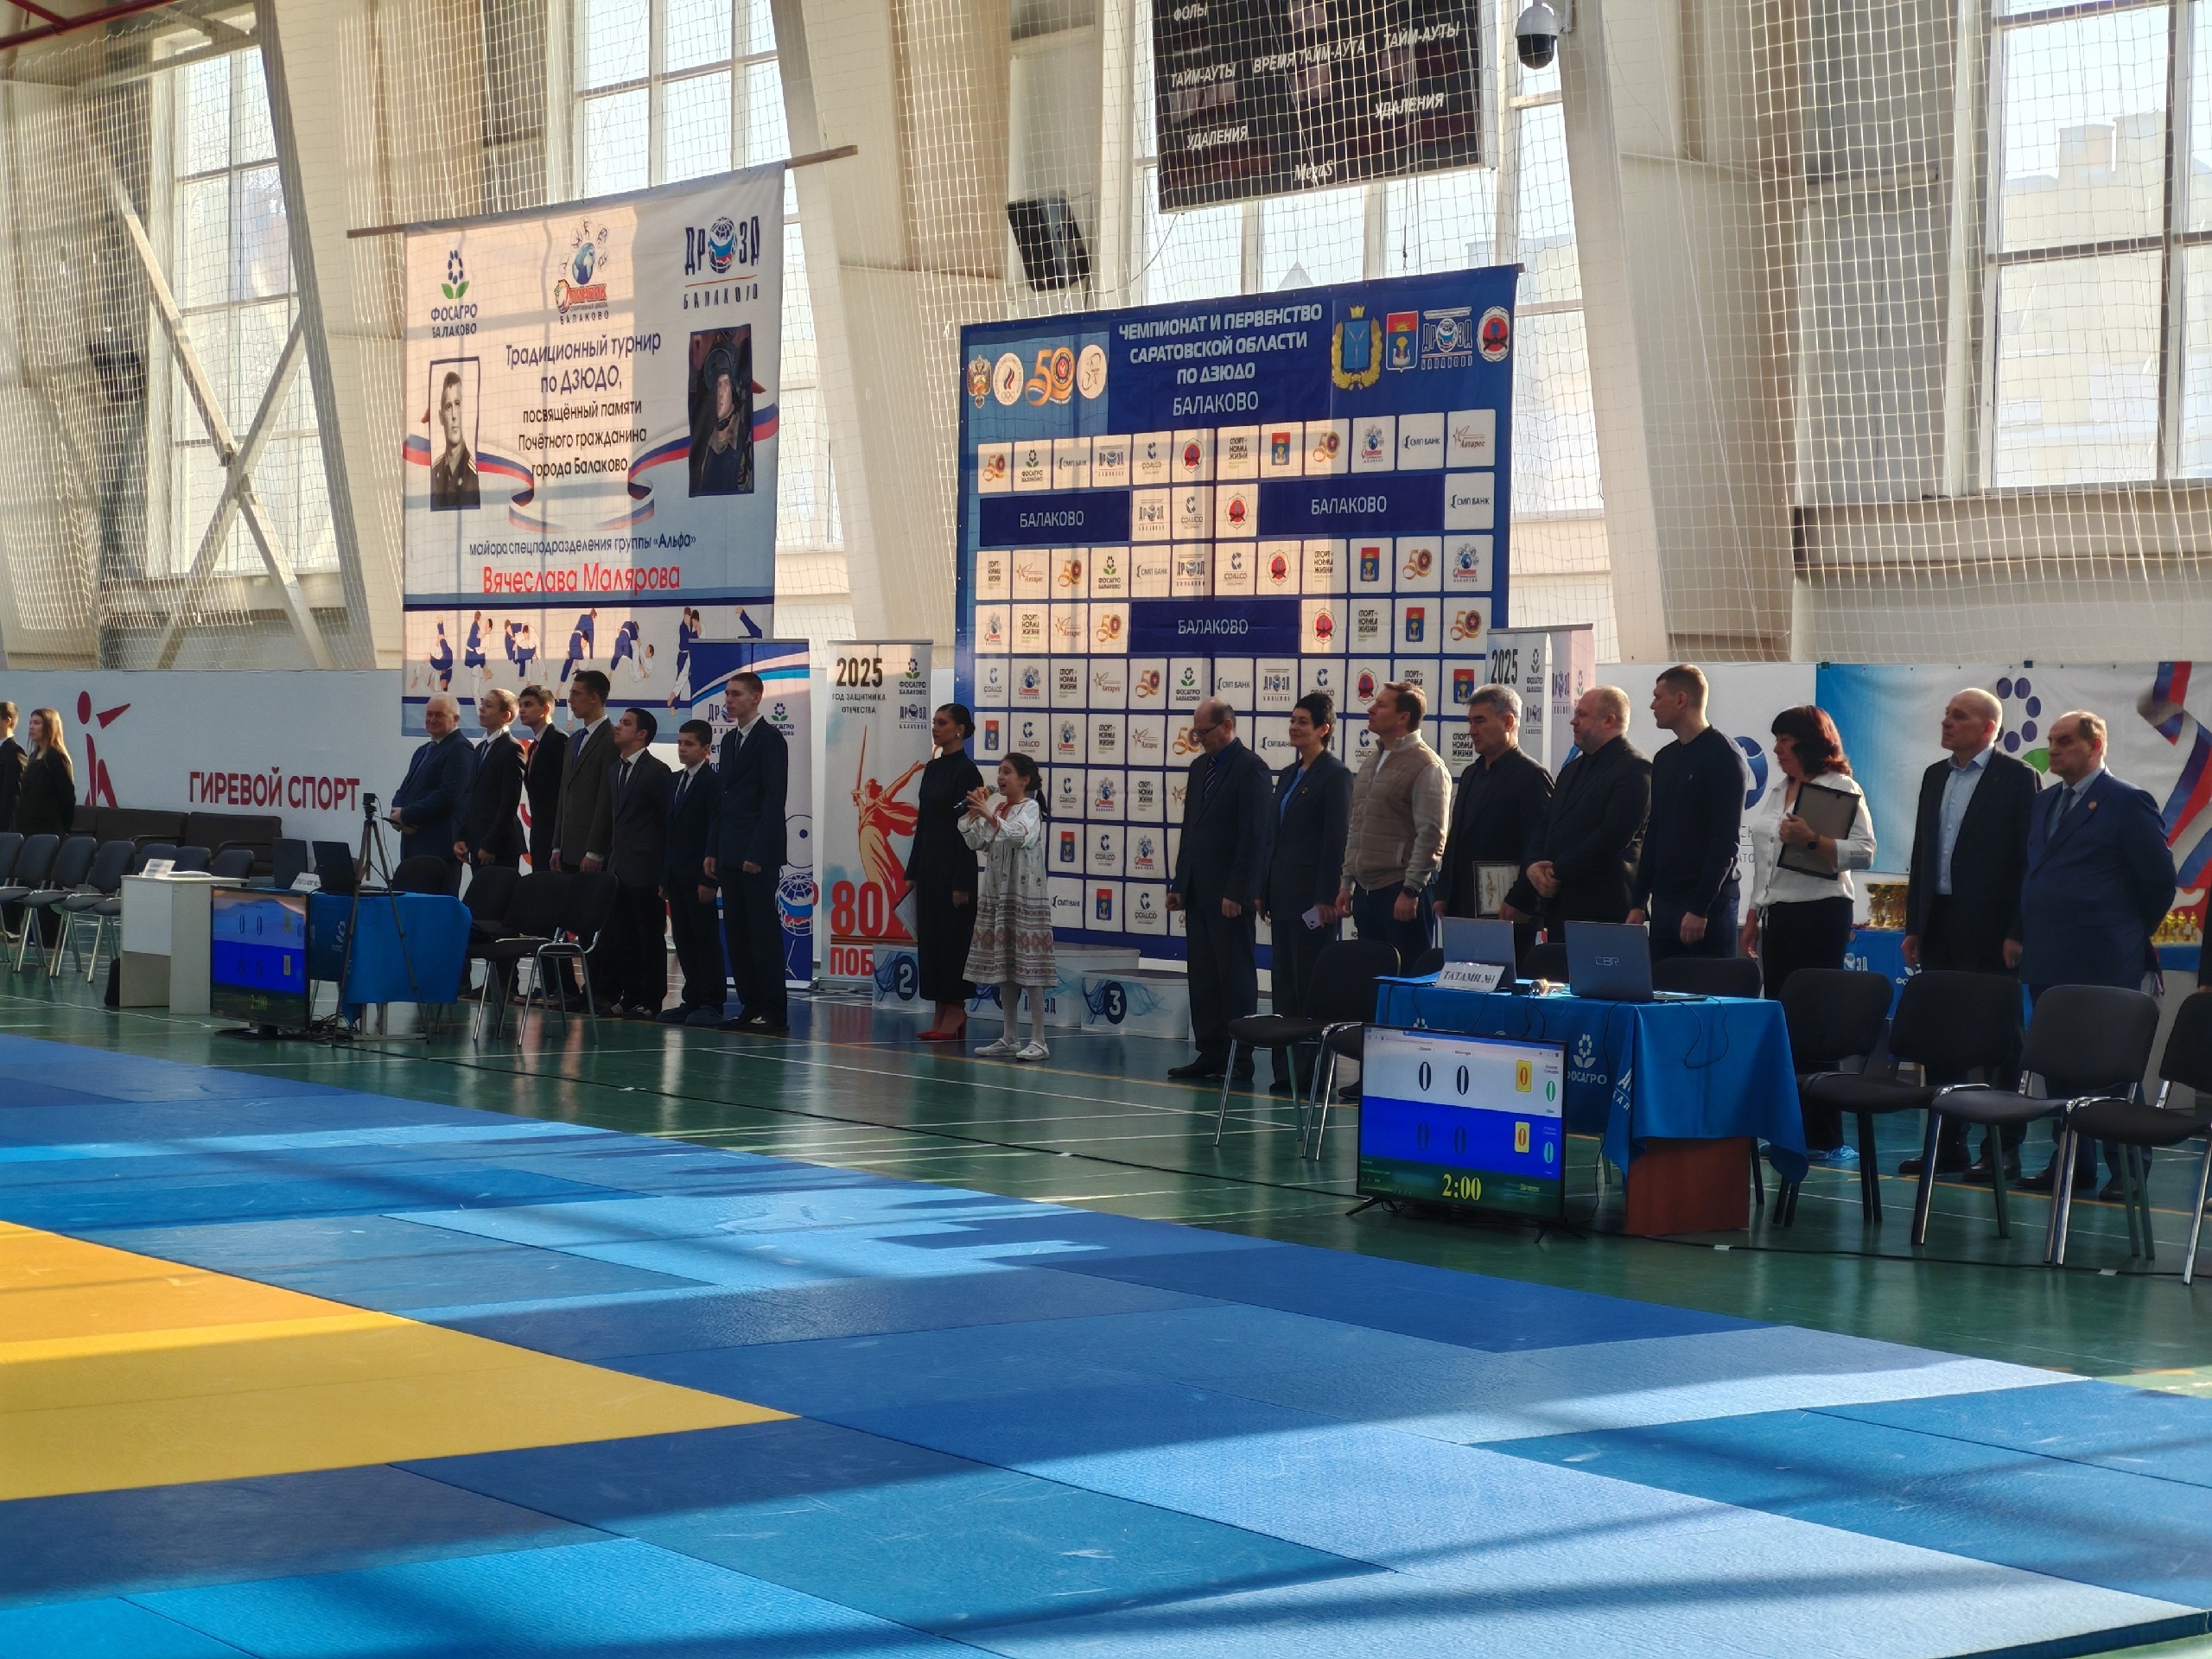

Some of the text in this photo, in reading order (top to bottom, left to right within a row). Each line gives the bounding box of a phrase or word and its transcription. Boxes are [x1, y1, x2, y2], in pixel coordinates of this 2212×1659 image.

[1173, 2, 1208, 22] ФОЛЫ
[1383, 21, 1460, 49] ТАЙМ-АУТЫ
[1171, 62, 1237, 87] ТАЙМ-АУТЫ
[1254, 53, 1295, 73] ВРЕМЯ
[1375, 92, 1445, 120] УДАЛЕНИЯ
[1187, 125, 1249, 151] УДАЛЕНИЯ
[430, 303, 478, 321] ФОСАГРО
[560, 310, 609, 325] БАЛАКОВО
[1118, 303, 1322, 340] ЧЕМПИОНАТ И ПЕРВЕНСТВО
[432, 323, 477, 338] БАЛАКОВО
[506, 332, 661, 370] Традиционный турнир
[1129, 331, 1307, 364] САРАТОВСКОЙ ОБЛАСТИ
[540, 365, 622, 395] по ДЗЮДО,
[1177, 362, 1255, 385] ПО ДЗЮДО
[523, 400, 642, 423] посвящённый памяти
[1173, 391, 1259, 416] БАЛАКОВО
[518, 428, 646, 451] Почётного гражданина
[532, 461, 571, 480] города
[1311, 495, 1387, 515] БАЛАКОВО
[1471, 497, 1490, 505] БАНК
[1020, 511, 1084, 528] БАЛАКОВО
[469, 531, 696, 559] майора спецподразделения группы «Альфа»
[483, 563, 680, 596] Вячеслава Малярова
[1178, 619, 1249, 635] БАЛАКОВО
[836, 658, 883, 688] 2025
[1491, 648, 1518, 684] 2025
[846, 693, 886, 702] ЗАЩИТНИКА
[189, 766, 360, 811] ГИРЕВОЙ СПОРТ
[830, 880, 883, 937] 80
[1595, 956, 1619, 966] CBR
[899, 963, 912, 994] 2
[1443, 970, 1480, 983] ТАТАМИ
[1109, 990, 1121, 1016] 3
[1419, 1061, 1556, 1102] 0 0 0 0
[1518, 1128, 1527, 1147] 0
[1543, 1141, 1554, 1164] 0
[1441, 1173, 1482, 1201] 2:00
